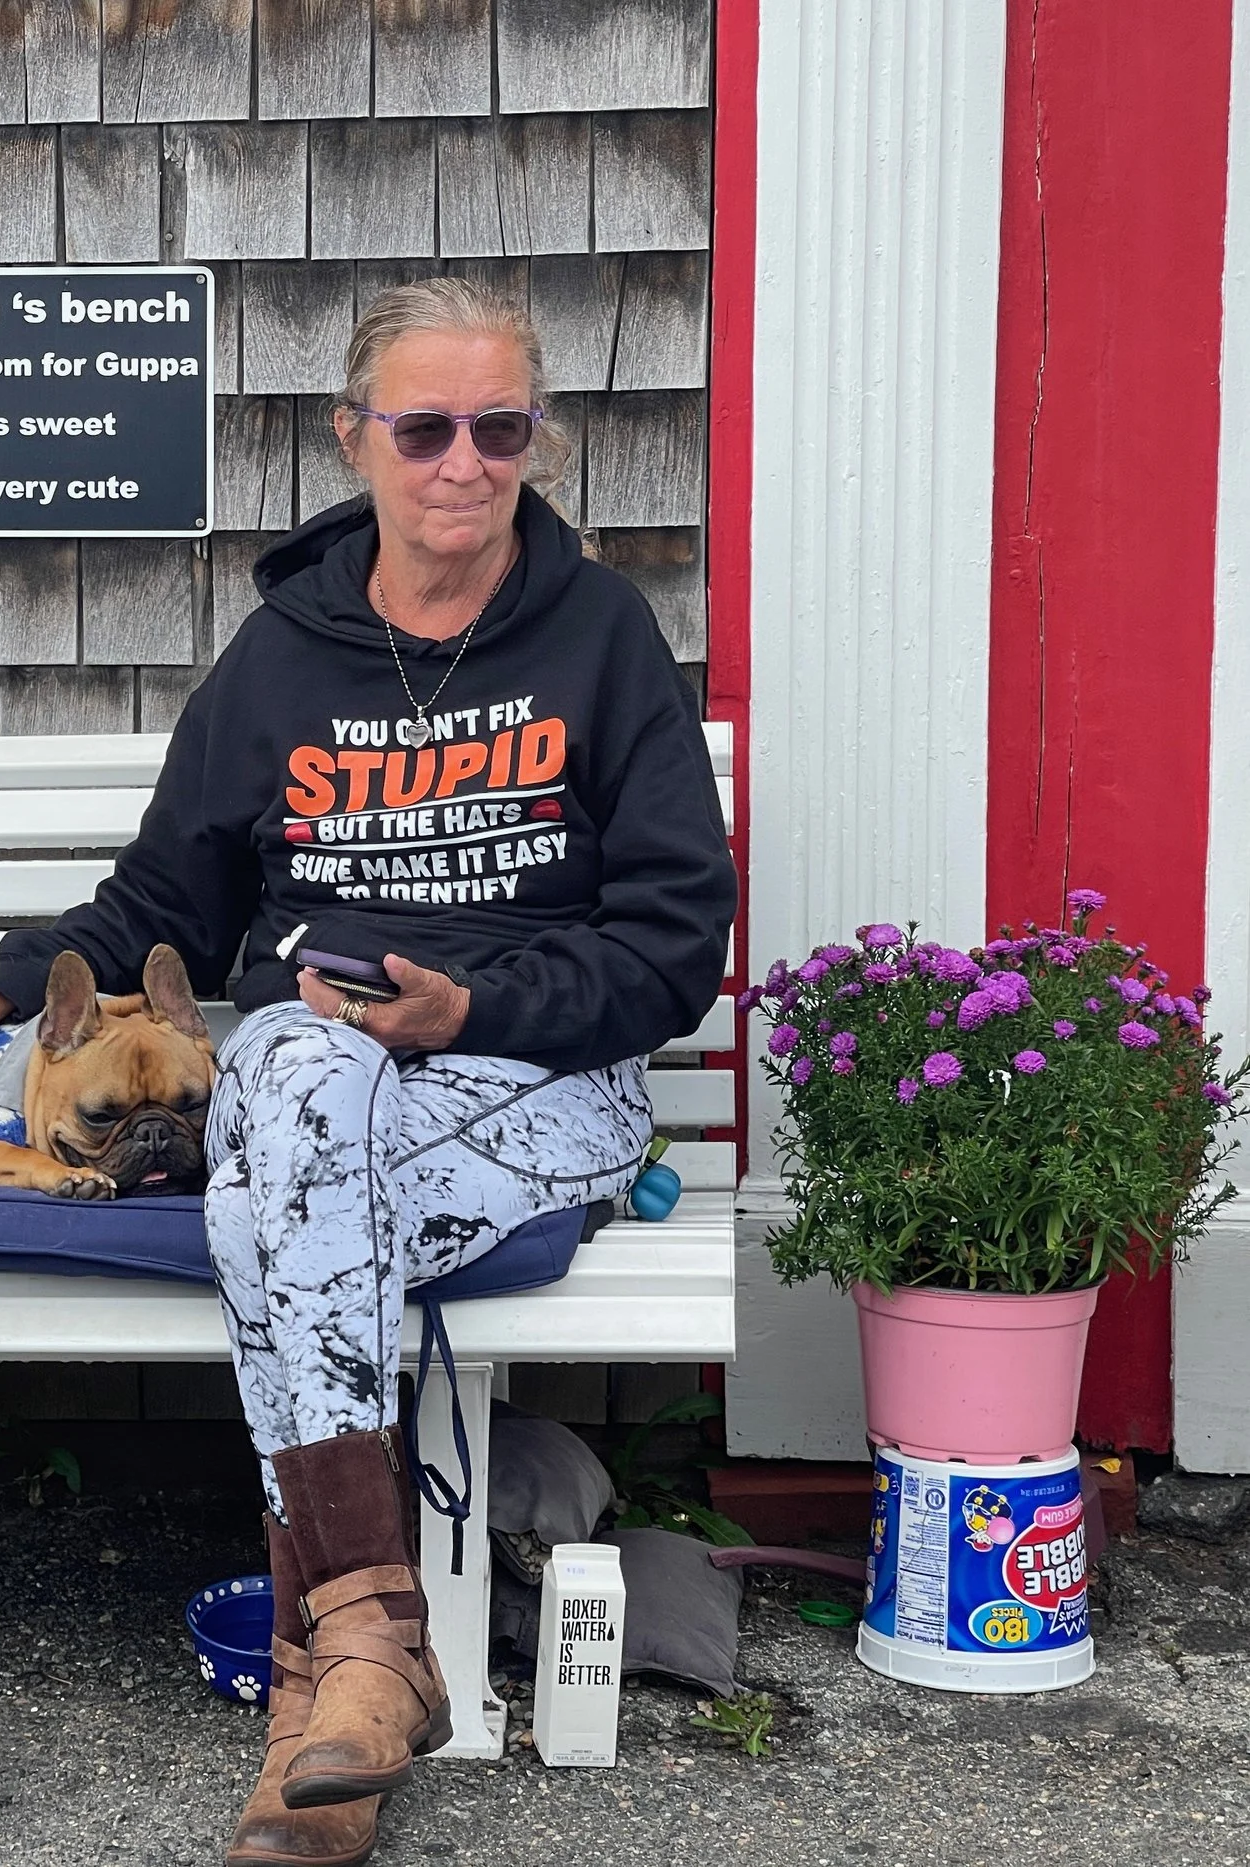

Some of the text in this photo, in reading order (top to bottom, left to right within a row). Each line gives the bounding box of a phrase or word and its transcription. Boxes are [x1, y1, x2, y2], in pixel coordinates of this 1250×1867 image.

[61, 290, 190, 324] bench
[41, 351, 88, 377] for
[95, 351, 199, 382] Guppa
[19, 412, 117, 436] sweet
[67, 475, 140, 499] cute
[332, 718, 389, 747] YOU
[488, 695, 534, 732] FIX
[285, 717, 567, 817] STUPID
[318, 803, 522, 842] BUT THE HATS
[290, 831, 568, 883] SURE MAKE IT EASY
[379, 873, 520, 905] IDENTIFY
[1041, 1511, 1064, 1524] GUM
[1016, 1524, 1085, 1569] UBBLE
[1024, 1549, 1086, 1596] UBBLE
[562, 1598, 607, 1620] BOXED
[561, 1621, 607, 1642] WATER
[913, 1634, 945, 1645] Nutrition
[984, 1616, 1030, 1643] 180
[559, 1642, 574, 1664] IS
[558, 1664, 614, 1686] BETTER.
